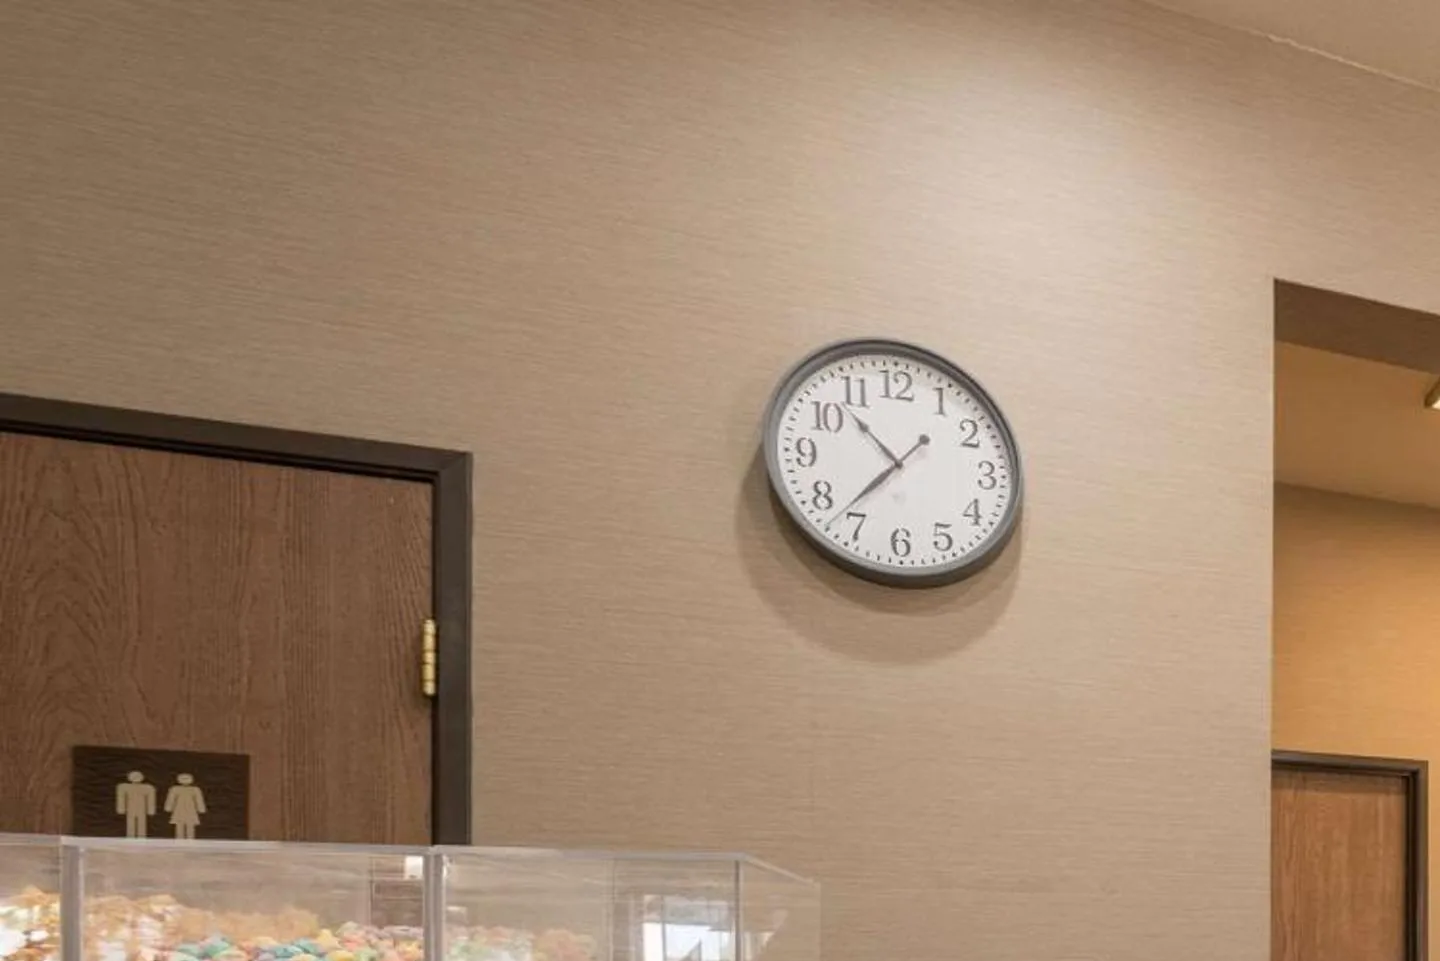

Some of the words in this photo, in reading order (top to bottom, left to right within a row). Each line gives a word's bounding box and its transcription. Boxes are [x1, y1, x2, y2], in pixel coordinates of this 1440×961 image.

[841, 375, 870, 408] 11
[879, 370, 914, 402] 12
[932, 386, 948, 417] 1
[811, 400, 844, 433] 10
[958, 418, 980, 448] 2
[795, 436, 817, 468] 9
[977, 460, 997, 490] 3
[811, 480, 833, 511] 8
[846, 511, 867, 542] 7
[962, 498, 981, 527] 4
[890, 527, 911, 558] 6
[932, 522, 953, 551] 5
